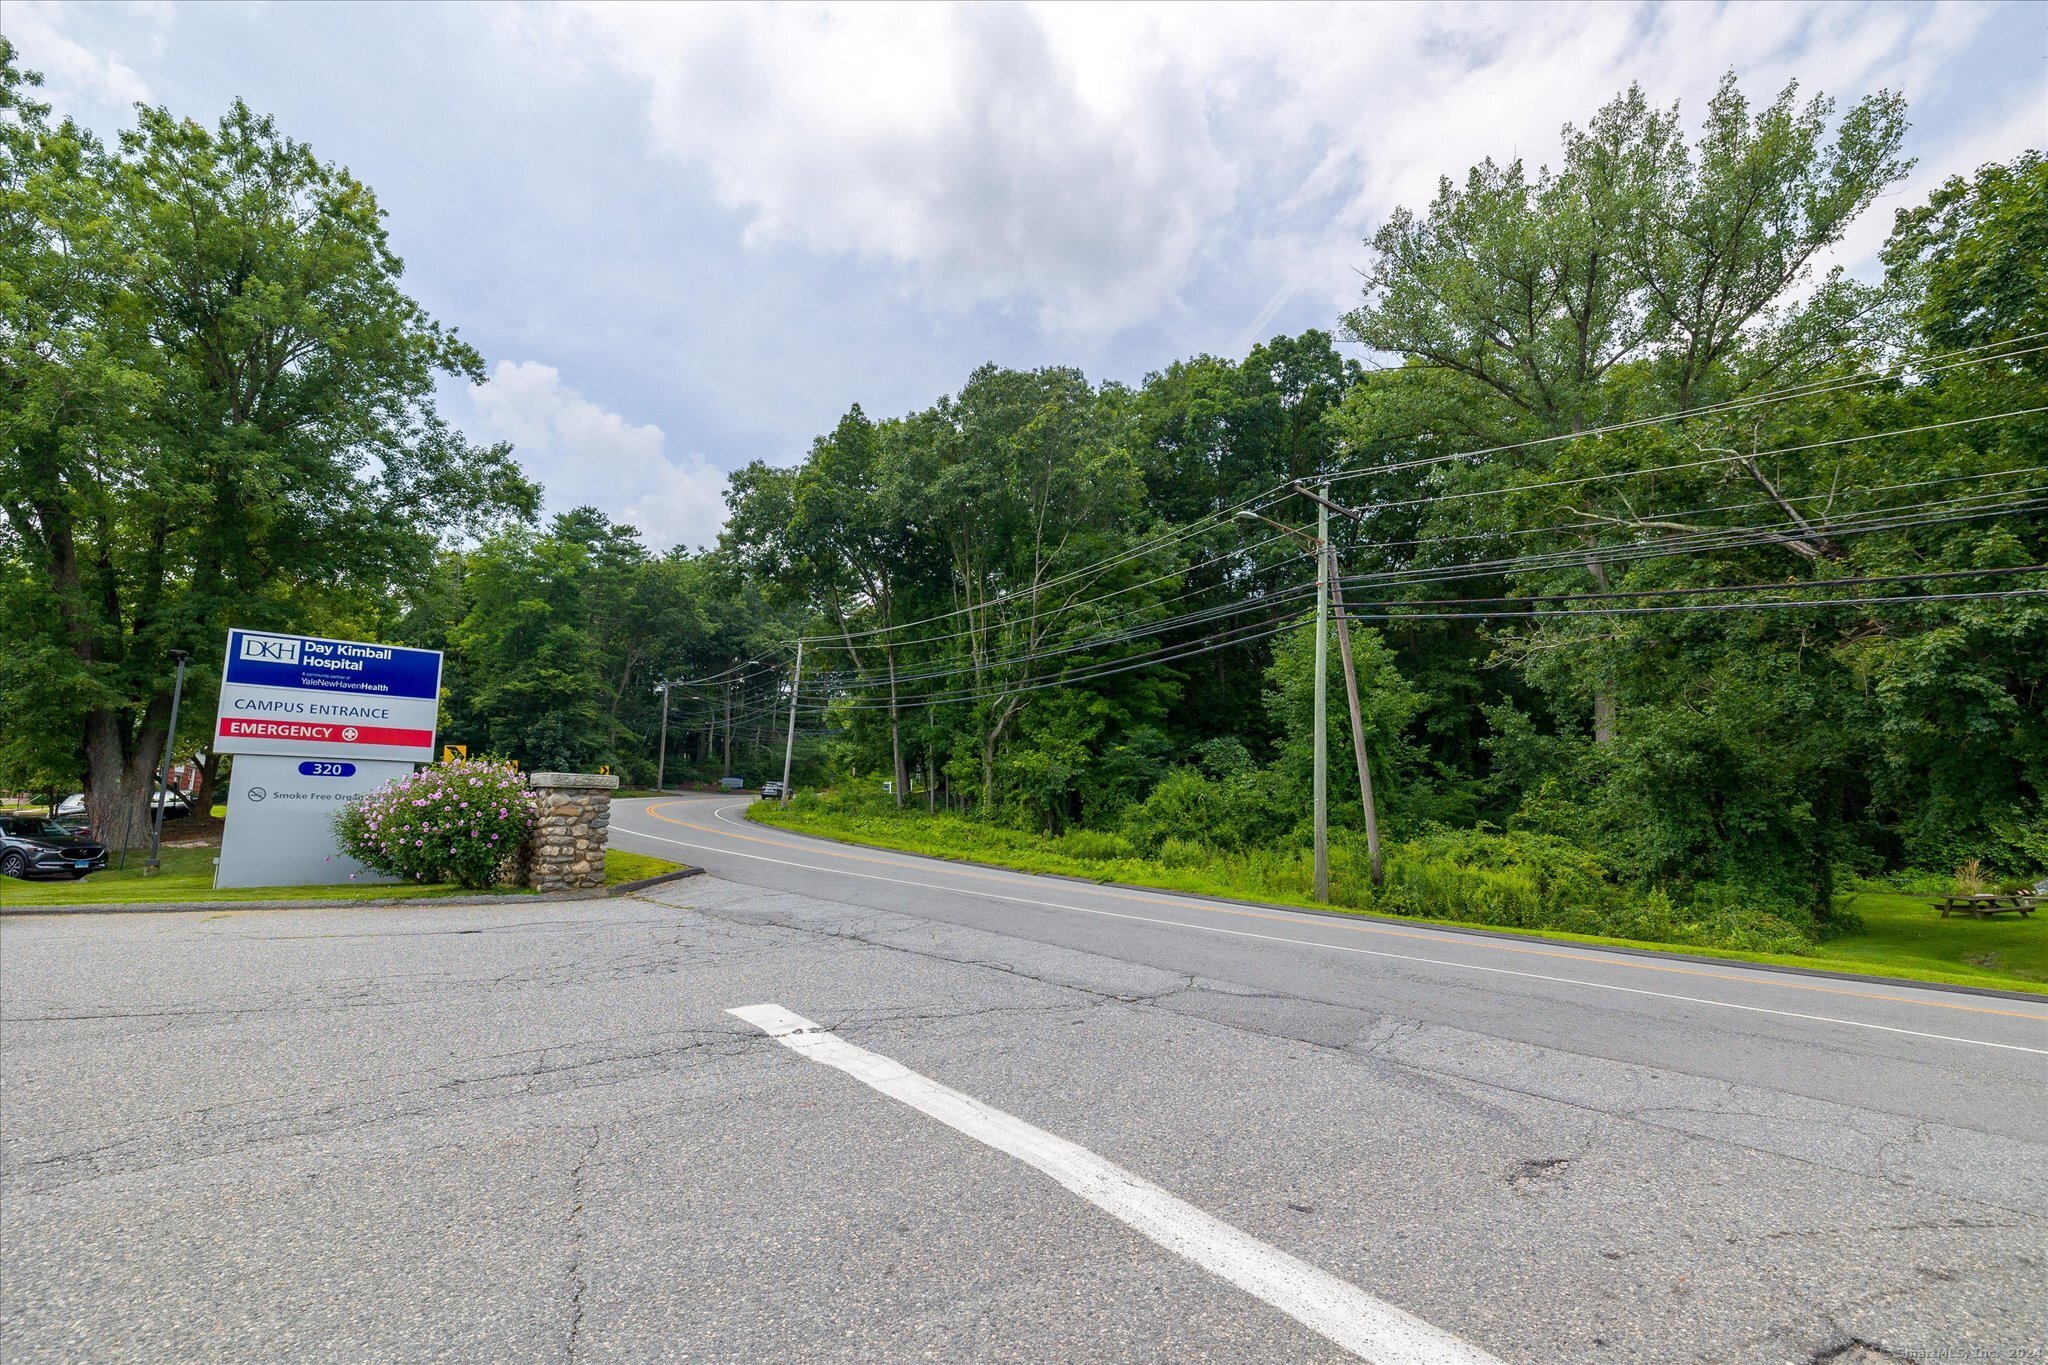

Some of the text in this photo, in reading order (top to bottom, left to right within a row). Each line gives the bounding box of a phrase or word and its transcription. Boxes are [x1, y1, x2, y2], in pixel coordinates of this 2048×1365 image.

[245, 640, 296, 660] DKH
[304, 641, 392, 660] Day Kimball
[302, 655, 363, 671] Hospital
[301, 677, 389, 692] YaleNewHavenHealth
[234, 698, 389, 719] CAMPUS ENTRANCE
[230, 722, 333, 738] EMERGENCY
[312, 763, 342, 775] 320
[273, 791, 308, 800] Smoke
[310, 792, 332, 800] Free
